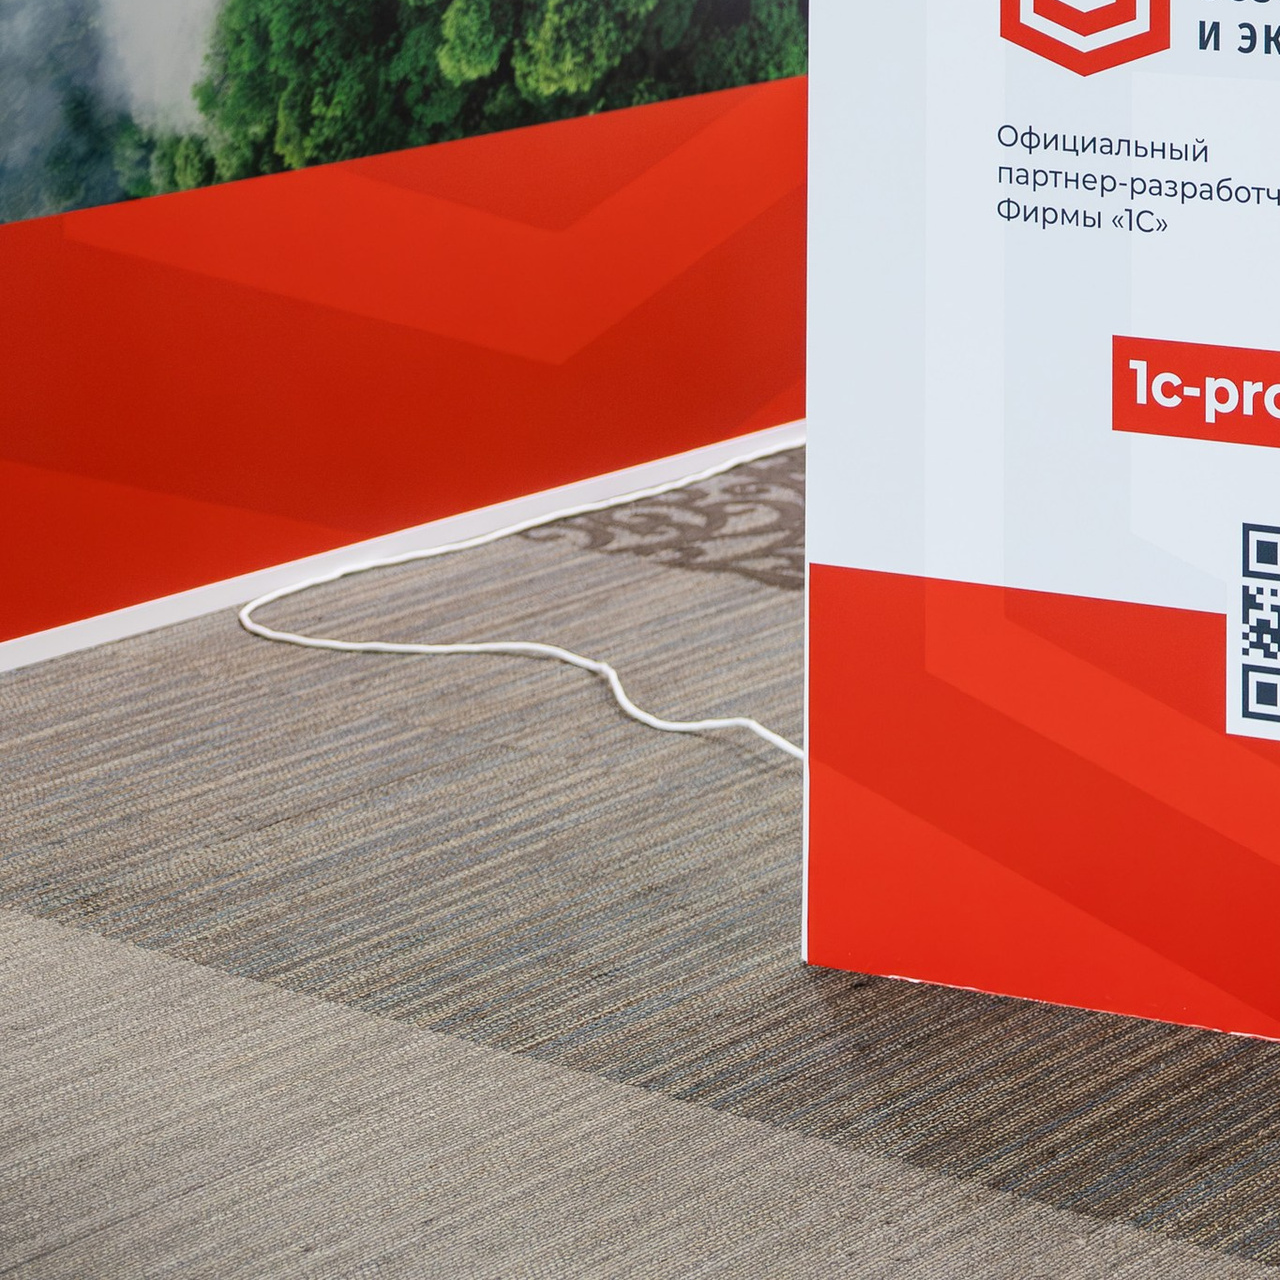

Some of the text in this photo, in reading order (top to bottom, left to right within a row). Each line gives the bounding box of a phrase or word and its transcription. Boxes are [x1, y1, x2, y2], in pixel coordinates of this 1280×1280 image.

[1198, 21, 1221, 51] и
[996, 124, 1210, 163] Официальный
[996, 197, 1169, 234] Фирмы «1С»
